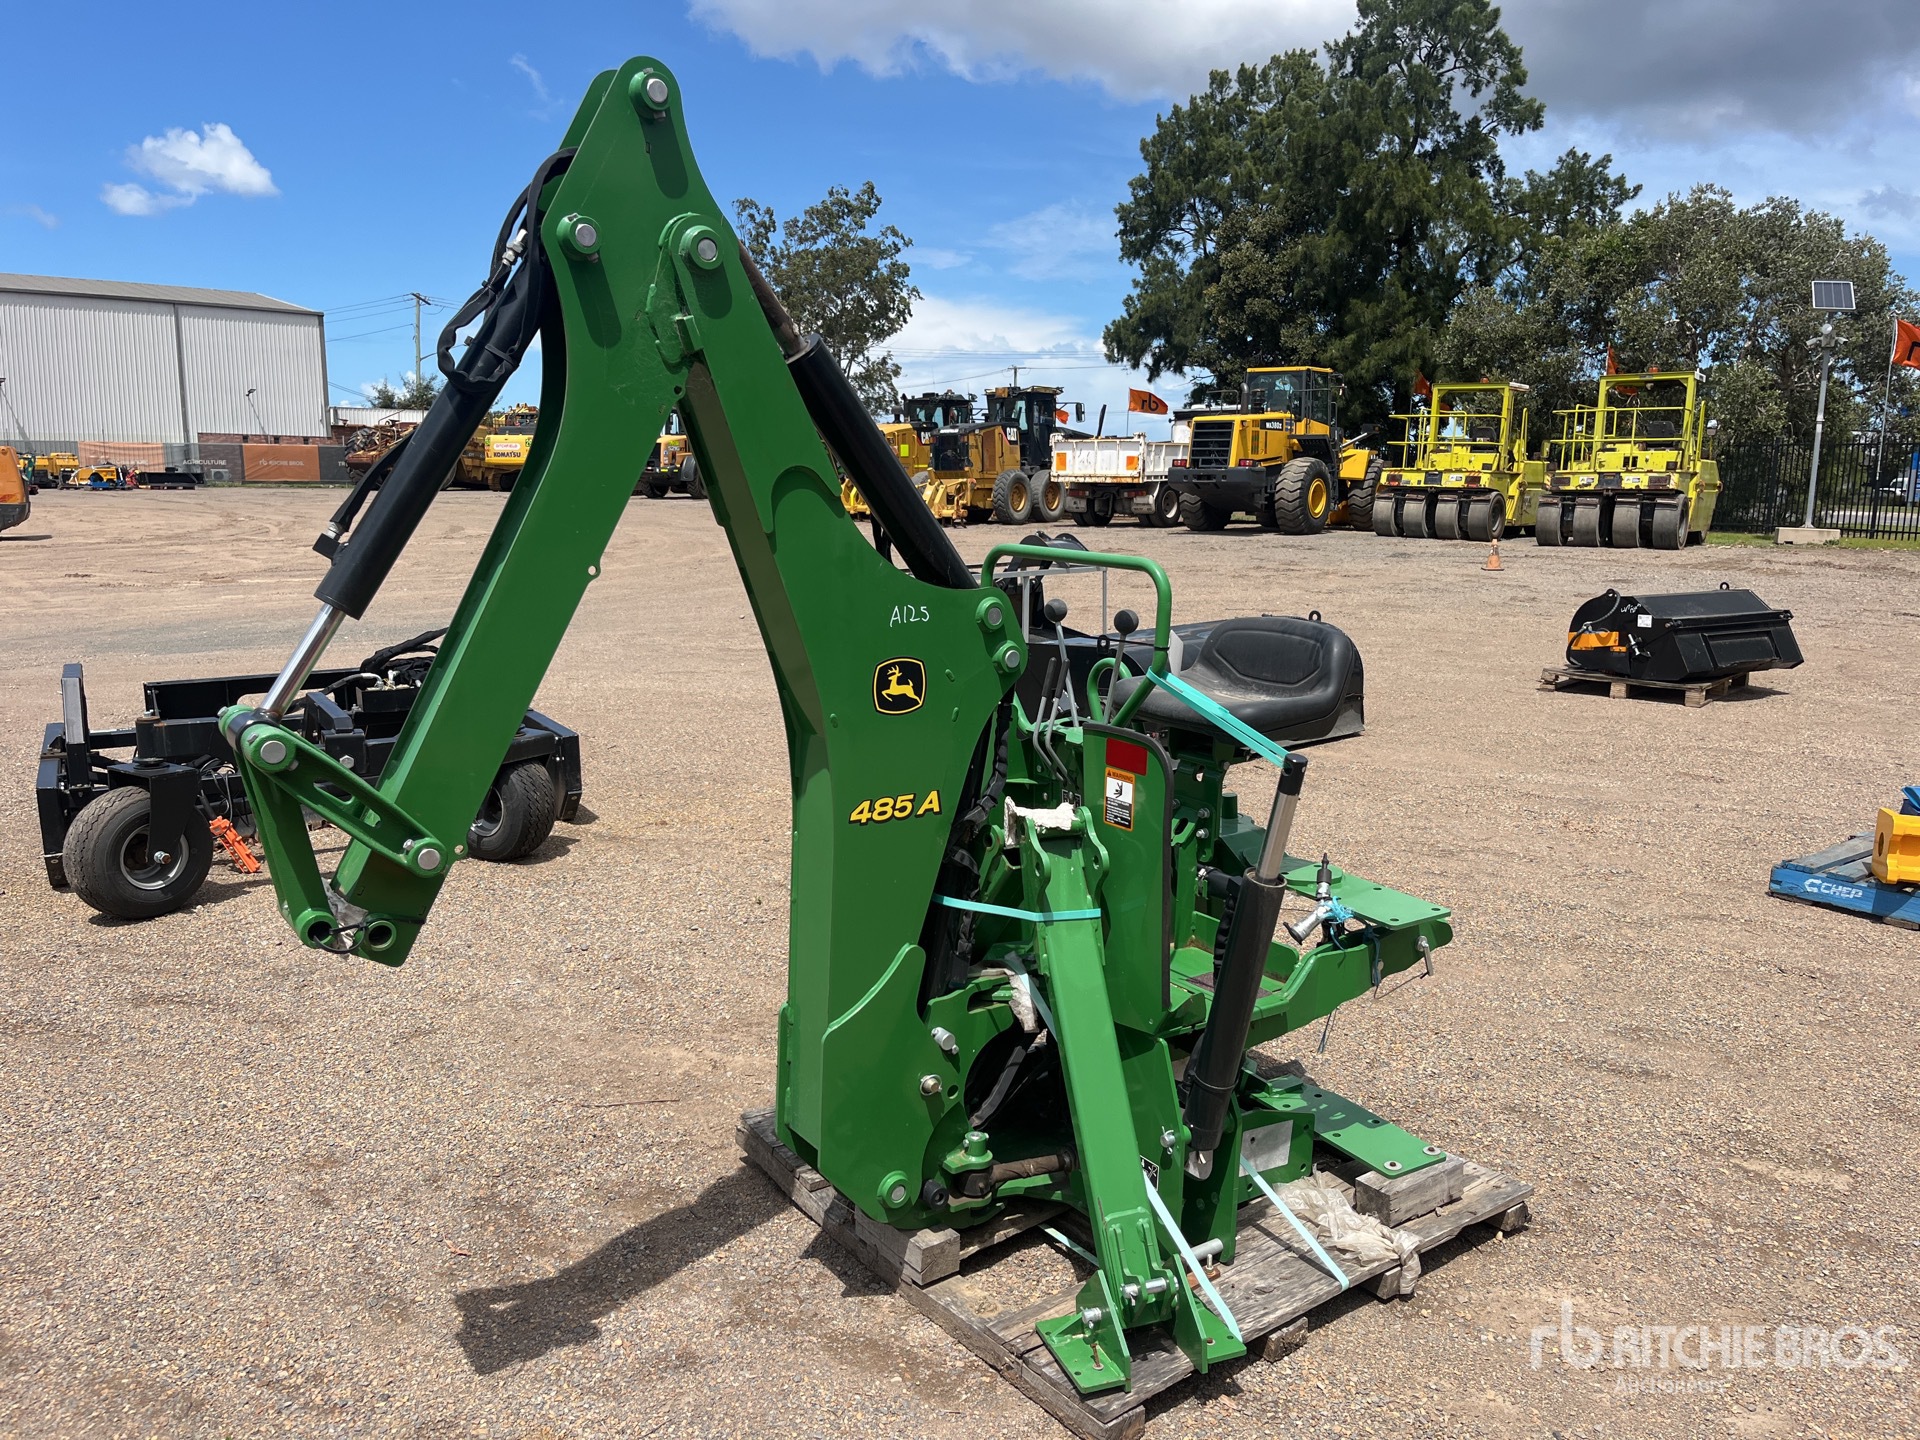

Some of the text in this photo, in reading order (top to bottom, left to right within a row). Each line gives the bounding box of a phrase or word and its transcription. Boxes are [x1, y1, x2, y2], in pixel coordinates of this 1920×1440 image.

[1141, 393, 1159, 412] rb
[1006, 427, 1017, 441] CAT
[889, 604, 930, 627] A125
[1111, 770, 1134, 783] WARNING
[1821, 882, 1863, 899] CHEP
